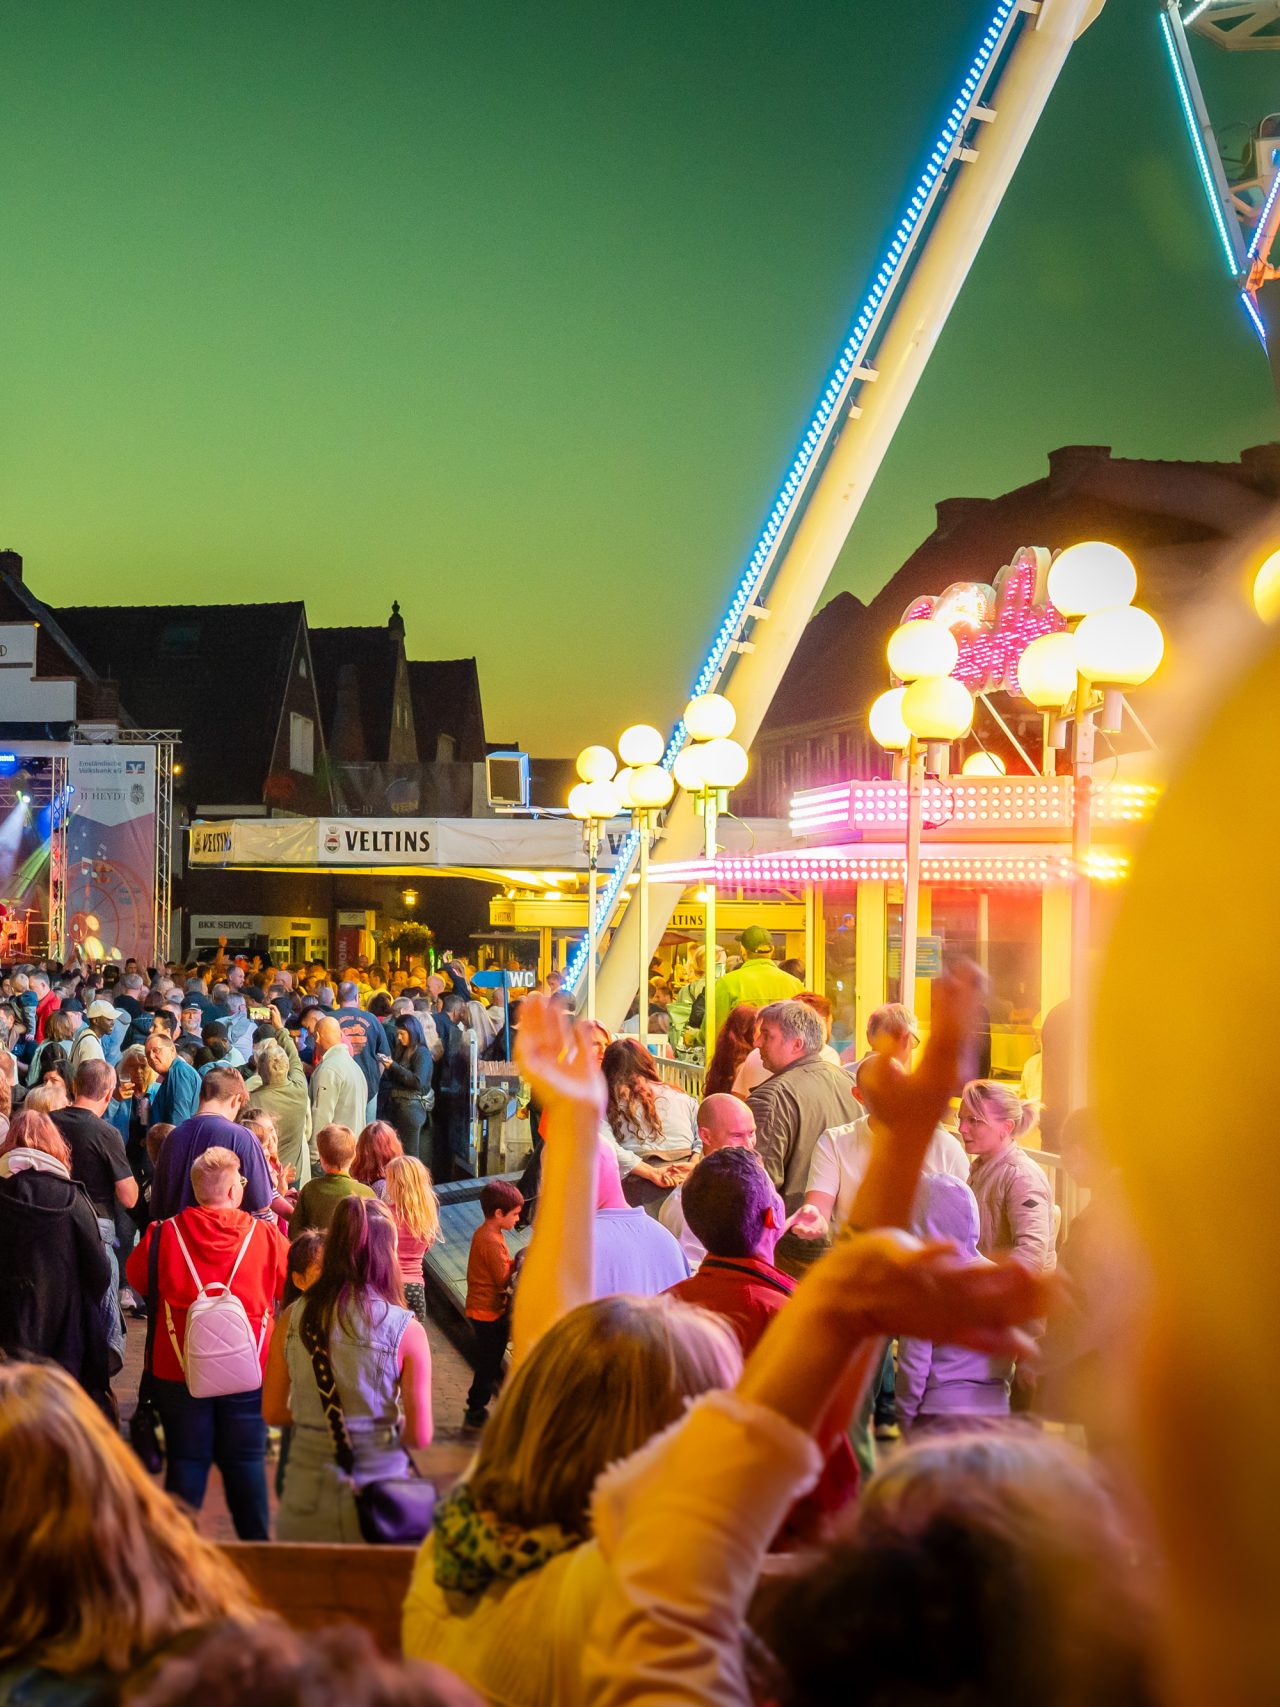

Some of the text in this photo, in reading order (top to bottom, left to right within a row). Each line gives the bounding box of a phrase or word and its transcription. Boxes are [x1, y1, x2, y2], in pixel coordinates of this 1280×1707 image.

[345, 831, 430, 852] VELTINS
[198, 921, 253, 929] BKK SERVICE
